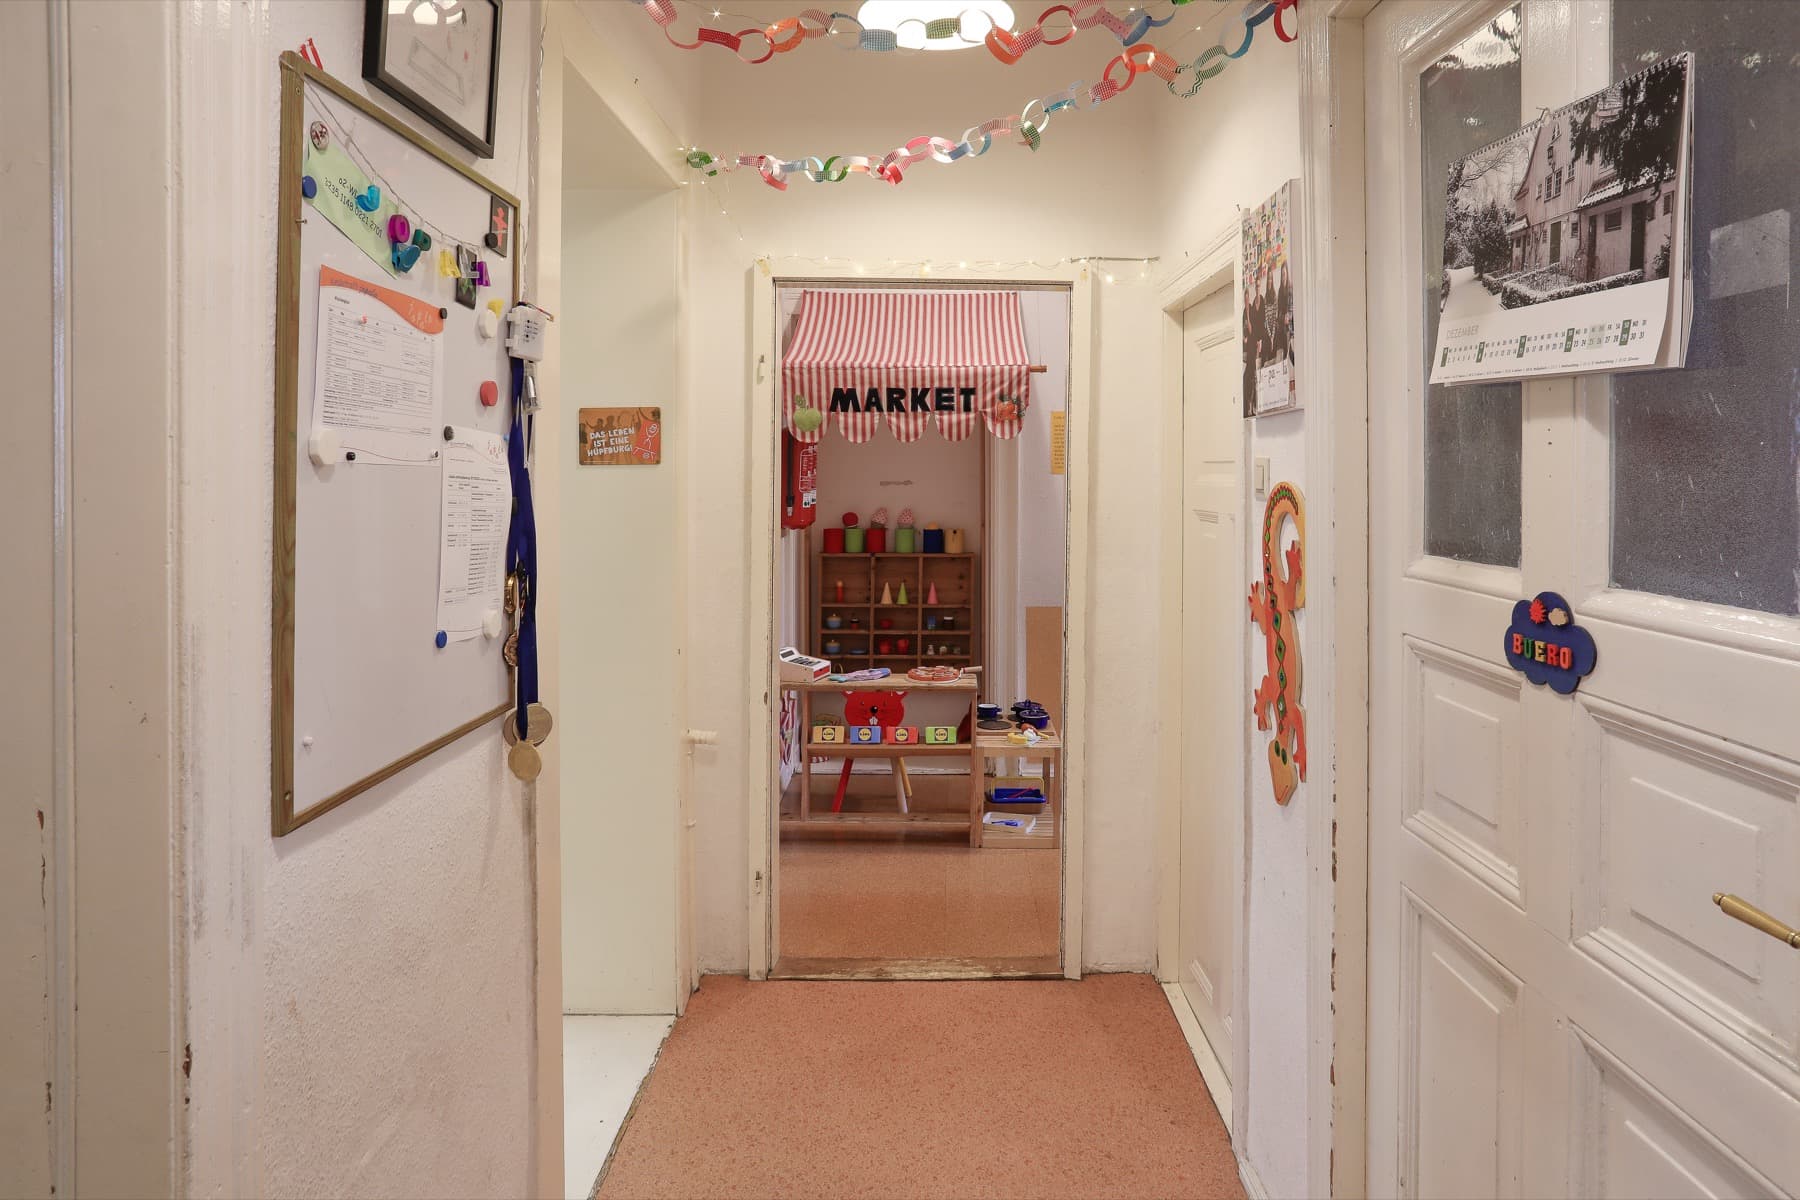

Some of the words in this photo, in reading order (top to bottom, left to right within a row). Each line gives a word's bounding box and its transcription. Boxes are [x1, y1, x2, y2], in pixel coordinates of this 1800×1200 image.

[829, 387, 977, 413] MARKET
[590, 431, 606, 440] DAS
[608, 426, 635, 438] LEBEN
[594, 439, 606, 448] IST
[610, 436, 630, 445] EINE
[586, 444, 633, 456] HÜPFBURG!
[1513, 634, 1572, 670] BUERO
